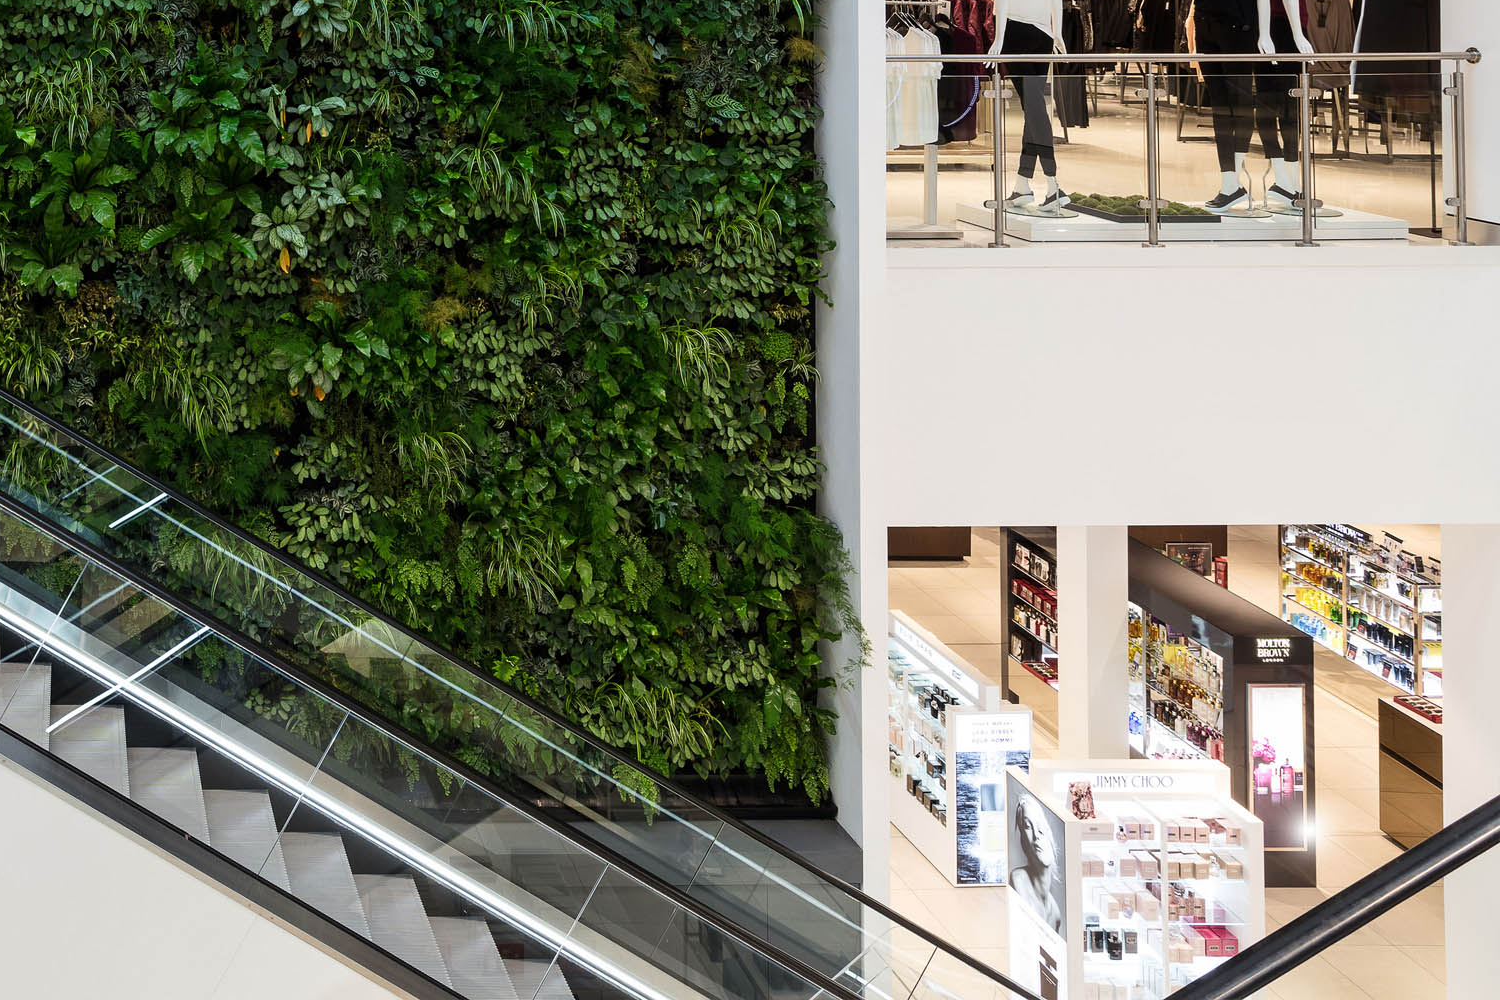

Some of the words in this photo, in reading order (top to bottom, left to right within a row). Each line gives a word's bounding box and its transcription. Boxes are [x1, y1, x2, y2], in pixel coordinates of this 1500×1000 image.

[1256, 638, 1291, 648] MOLTON
[1257, 648, 1290, 658] BROWN
[1092, 775, 1128, 788] JIMMY
[1131, 775, 1174, 788] CHOO
